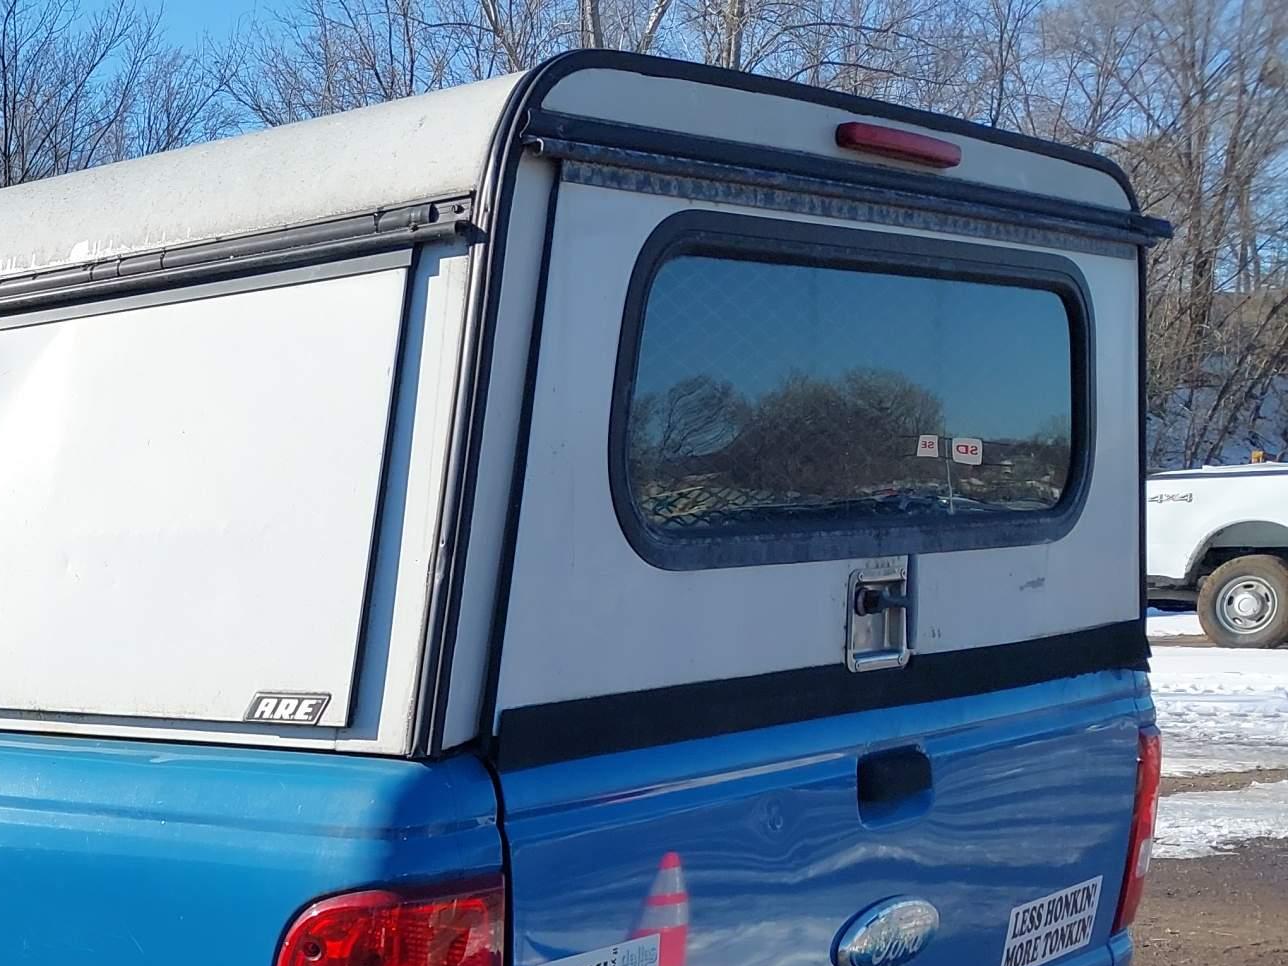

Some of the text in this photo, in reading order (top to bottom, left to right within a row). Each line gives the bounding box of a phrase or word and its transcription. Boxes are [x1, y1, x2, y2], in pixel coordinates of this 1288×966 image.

[1011, 883, 1097, 940] LESS HONKIN!
[1041, 914, 1093, 959] TONKIN!
